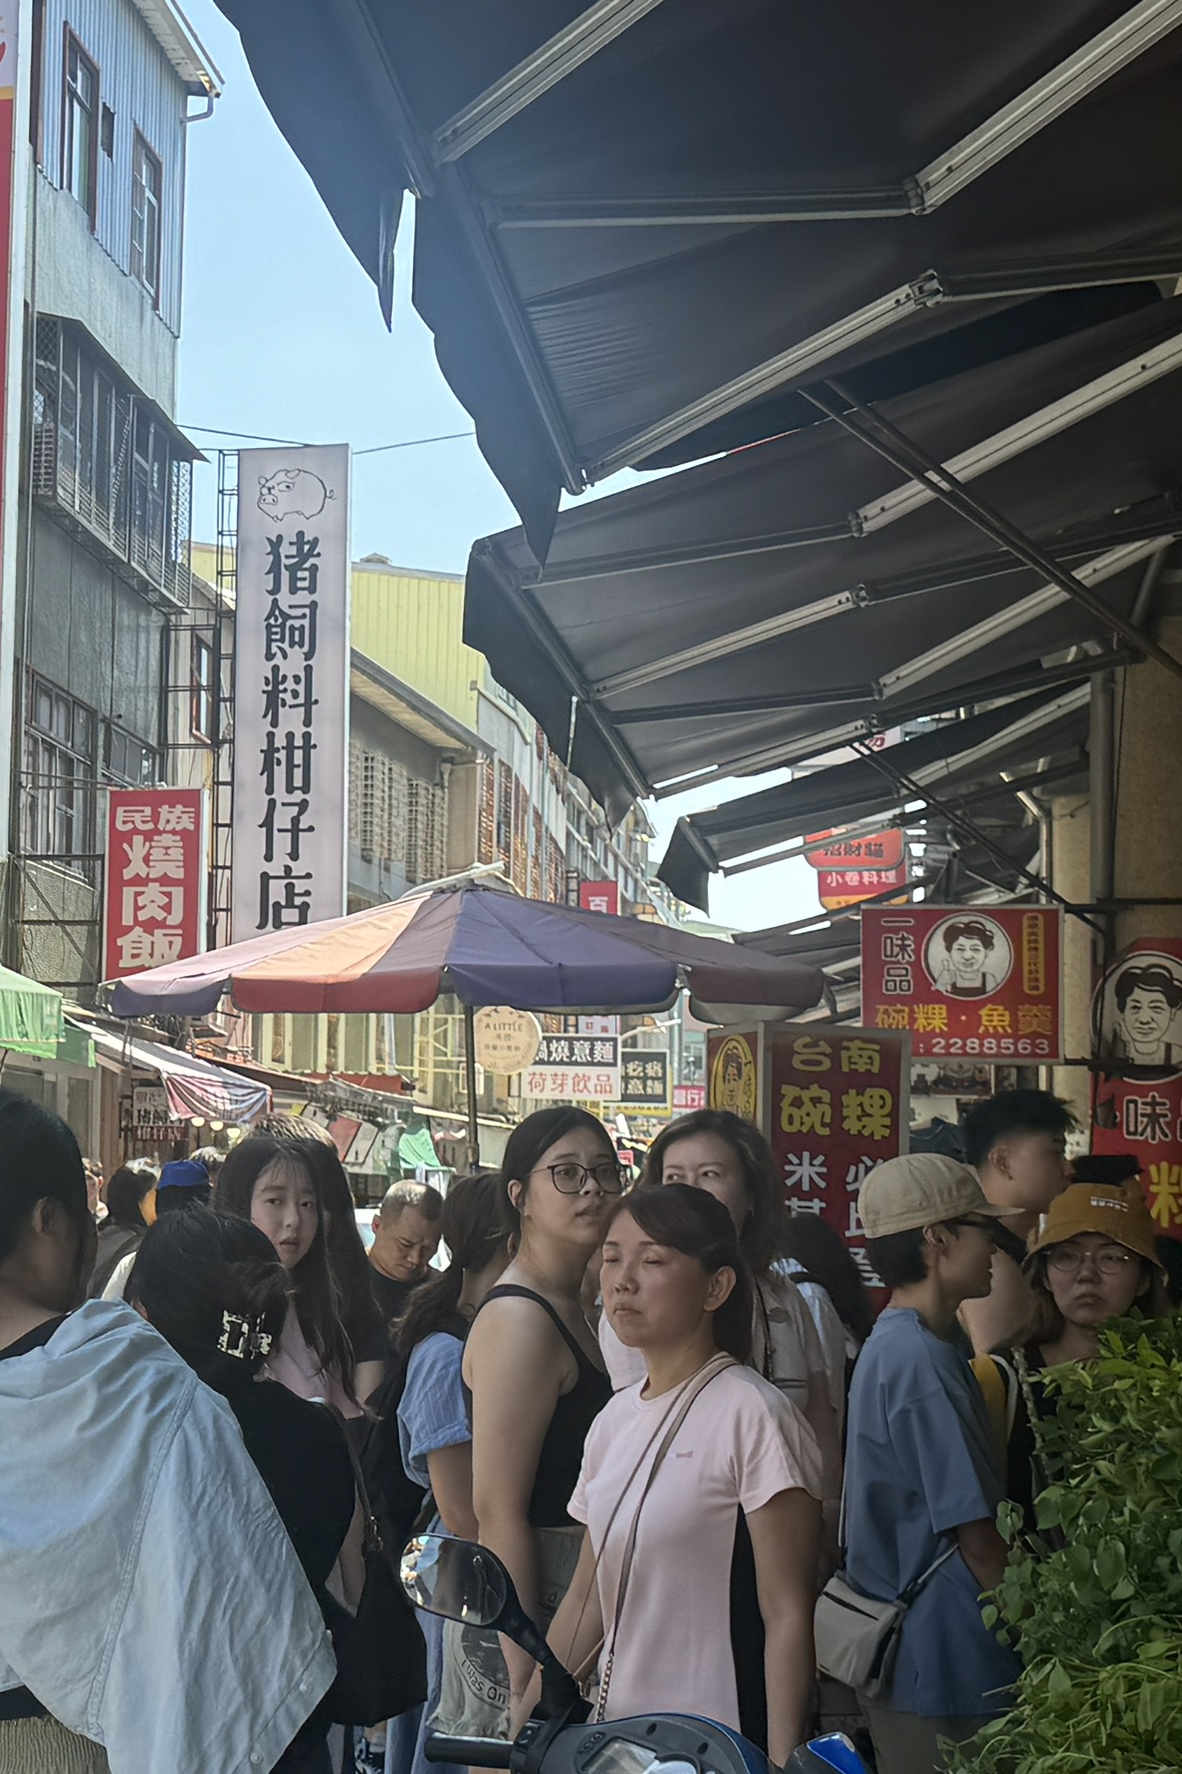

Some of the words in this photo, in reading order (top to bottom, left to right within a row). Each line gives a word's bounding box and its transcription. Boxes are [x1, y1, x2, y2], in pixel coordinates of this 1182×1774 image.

[114, 803, 195, 832] 民族
[116, 833, 186, 969] 燒肉飯
[880, 916, 915, 995] 一味品
[791, 1035, 882, 1074] 台南
[527, 1071, 614, 1095] 荷芽飲品
[779, 1082, 893, 1141] 碗粿
[486, 1686, 506, 1704] On
